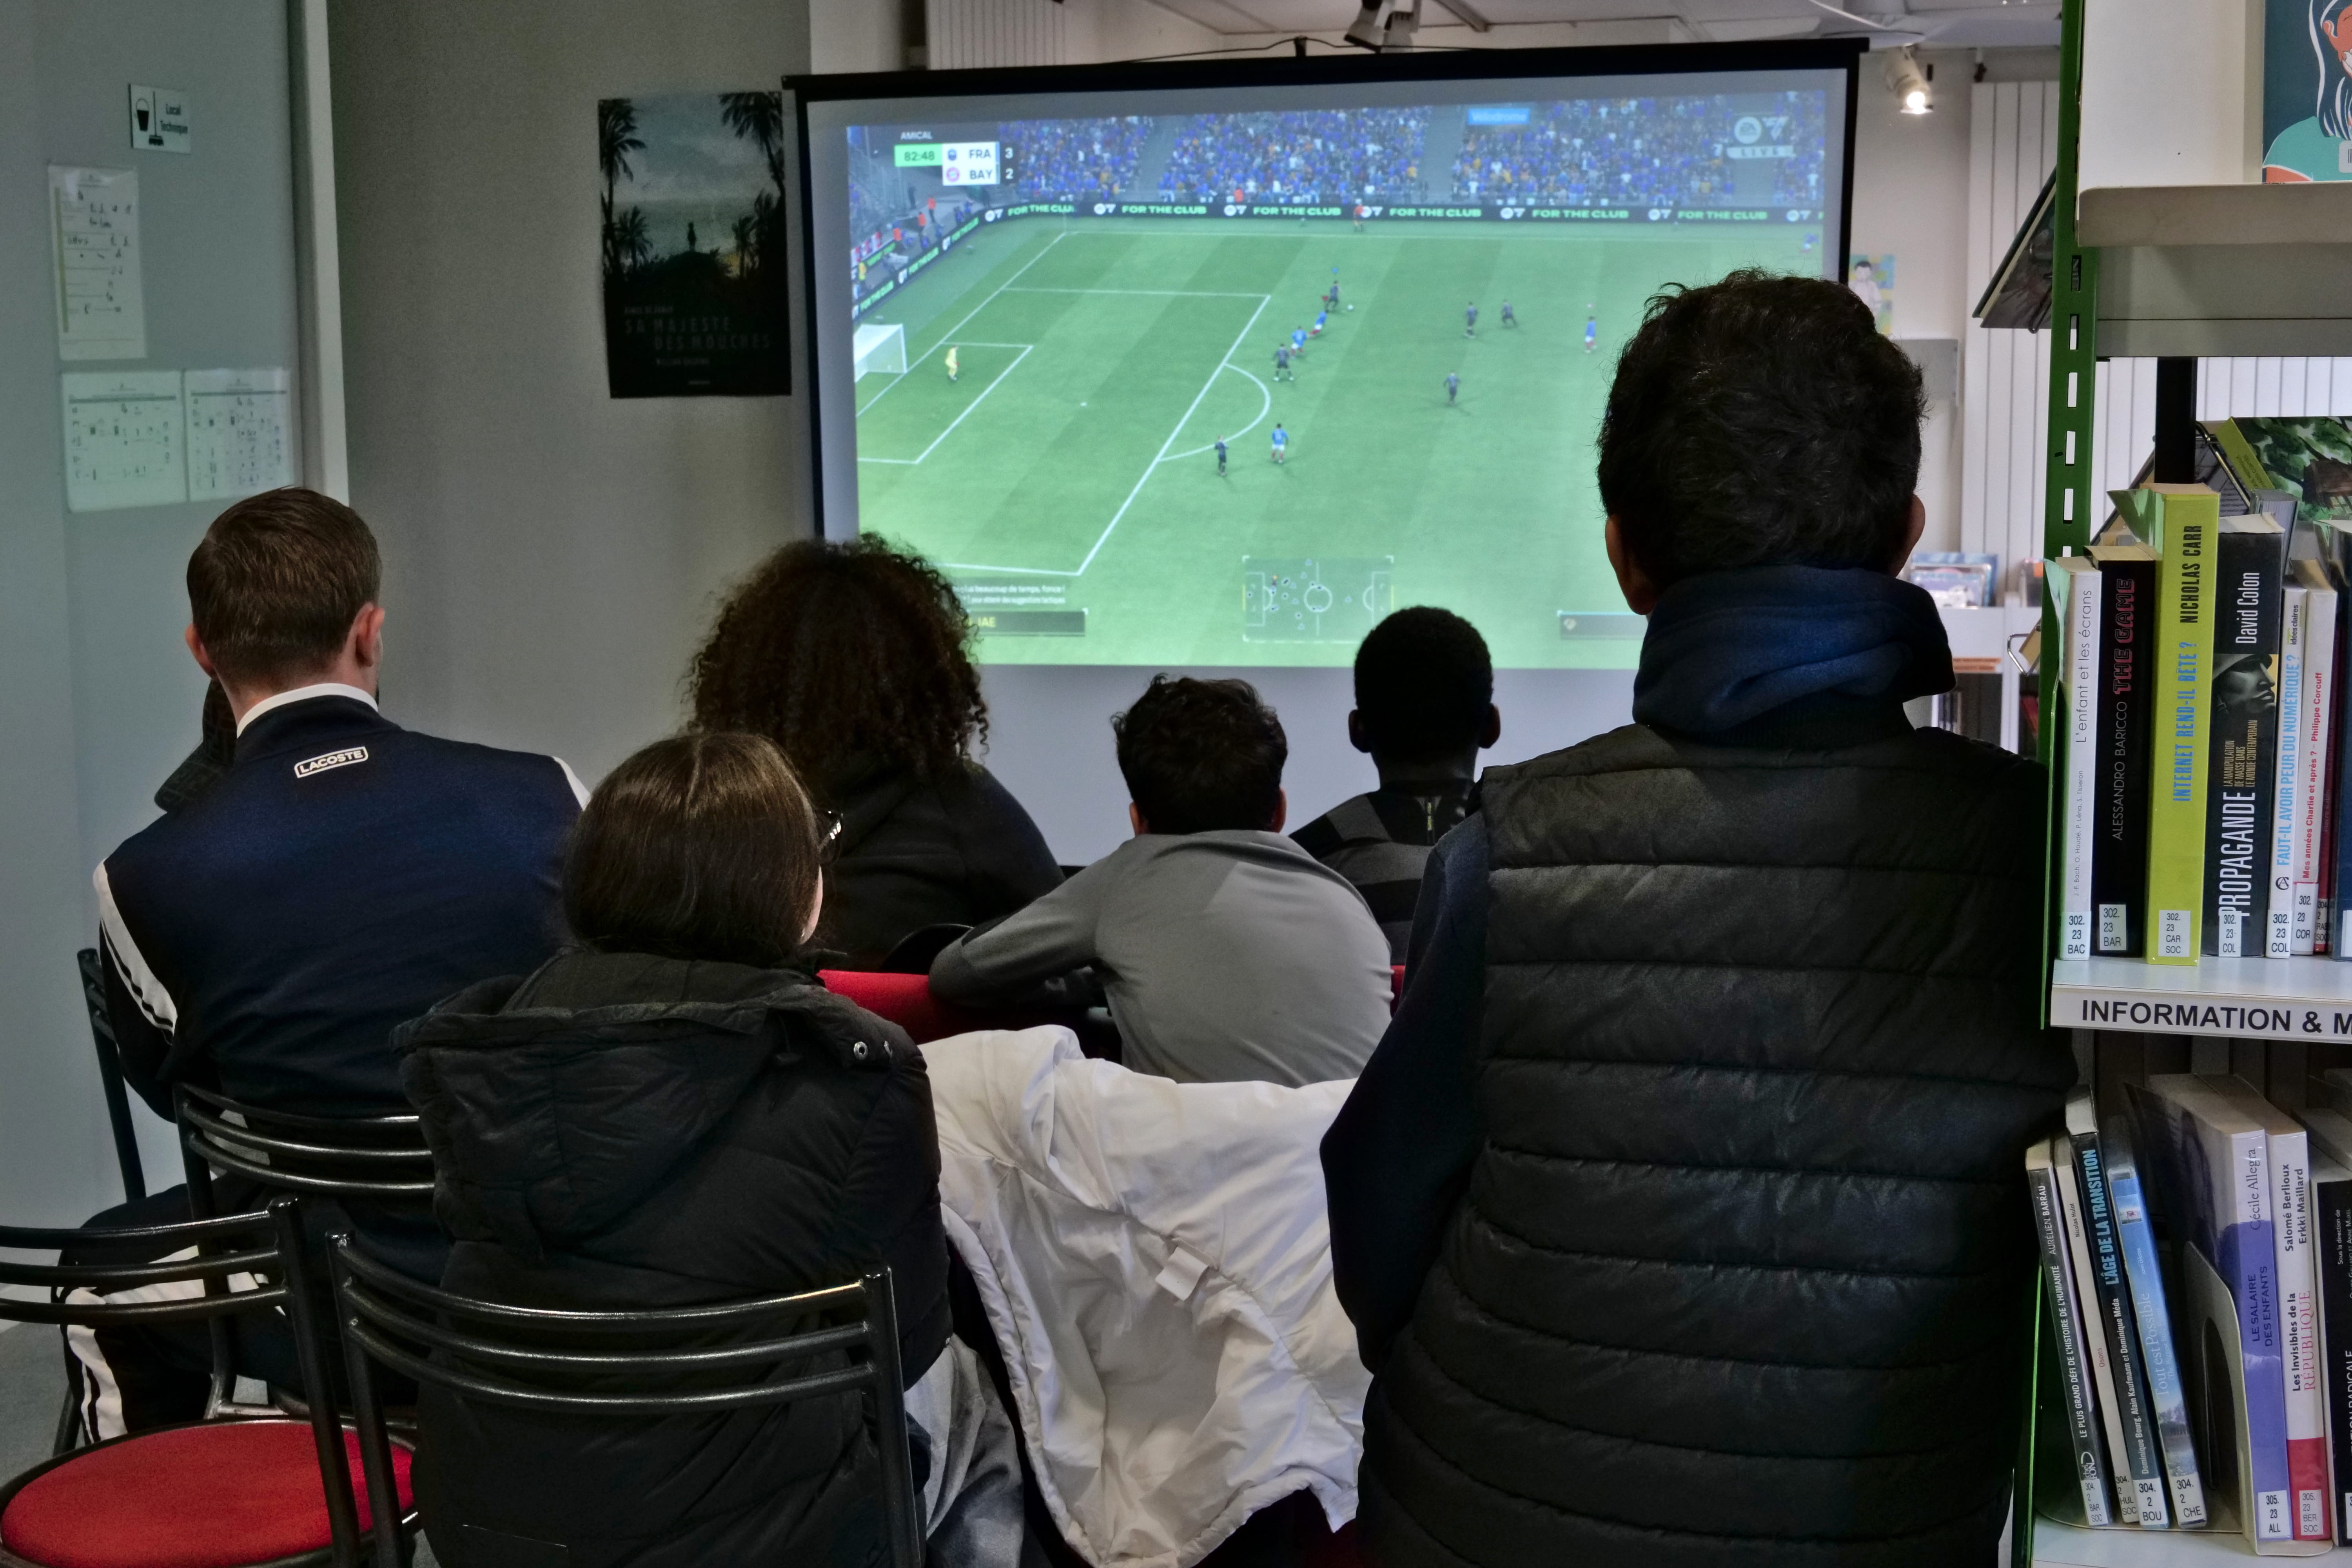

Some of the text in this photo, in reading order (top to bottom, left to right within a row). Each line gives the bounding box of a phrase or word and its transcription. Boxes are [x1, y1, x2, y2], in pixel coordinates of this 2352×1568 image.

[900, 131, 932, 140] AMICAL
[904, 151, 935, 161] 82:48
[969, 147, 1013, 159] FRA 3
[970, 168, 1014, 179] BAY 2
[1122, 205, 1207, 214] FOR THE CLUB
[1253, 206, 1341, 216] FOR THE CLUB
[1389, 208, 1482, 217] FOR THE CLUB
[1532, 209, 1629, 218] FOR THE CLUB
[1678, 211, 1768, 220] FOR THE CLUB
[625, 319, 645, 334] SA
[654, 333, 770, 350] DES MOUCHES
[2180, 525, 2202, 623] NICHOLAS CARR
[2236, 572, 2260, 644] David Colon
[2113, 579, 2135, 695] THE GAME
[2076, 590, 2092, 742] L'enfant et les écrans
[2314, 672, 2322, 704] Corcuff
[2282, 664, 2299, 732] NUMÉRIQUE
[2176, 688, 2196, 737] REND-IL
[2311, 707, 2321, 742] Philippe
[2247, 720, 2258, 761] CONTEMPORAIN
[2282, 735, 2296, 751] DU
[299, 750, 363, 773] LACOSTE
[2224, 740, 2234, 779] MANIPULATION
[2236, 746, 2245, 760] DANS
[2112, 702, 2127, 840] ALESSANDRO BARICCO
[2173, 744, 2194, 801] INTERNET
[2235, 760, 2245, 779] MASSE
[2246, 761, 2256, 780] MONDE
[2281, 753, 2295, 784] PEUR
[2308, 759, 2317, 782] après
[2279, 786, 2293, 821] AVOIR
[2306, 795, 2315, 826] Charlie
[2277, 826, 2292, 866] FAUT-IL
[2304, 828, 2312, 859] années
[2218, 792, 2255, 916] PROPAGANDE
[2303, 861, 2311, 878] Mes
[2299, 896, 2312, 905] 302.
[2069, 915, 2085, 925] 302.
[2103, 908, 2120, 918] 302.
[2224, 914, 2236, 924] 302.
[2273, 914, 2289, 924] 302.
[2298, 912, 2305, 922] 23
[2072, 930, 2082, 939] 23
[2103, 922, 2113, 932] 23
[2276, 929, 2286, 938] 23
[2296, 929, 2310, 939] COR
[2068, 944, 2085, 954] BAC
[2103, 937, 2121, 946] BAR
[2223, 943, 2236, 953] COL
[2271, 943, 2289, 953] COL
[2082, 1000, 2291, 1032] INFORMATION
[2302, 1011, 2322, 1033] &
[2246, 1148, 2260, 1230] Cécile Allegra
[2281, 1164, 2293, 1252] Salomé Berlioux
[2294, 1169, 2307, 1244] Erkki Maillard
[2038, 1185, 2056, 1254] AURÉLIEN BARRAU
[2082, 1149, 2119, 1285] L'ÂGE DE LA TRANSITION
[2112, 1298, 2122, 1317] Méda
[2248, 1274, 2260, 1342] LE SALAIRE
[2260, 1266, 2272, 1346] DES ENFANTS
[2117, 1318, 2128, 1353] Dominique
[2287, 1293, 2301, 1391] Les Invisibles de la
[2299, 1290, 2316, 1390] RÉPUBLIQUE
[2050, 1265, 2087, 1438] LE PLUS GRAND DÉFI DE L'HISTOIRE DE L'HUMANITÉ
[2137, 1293, 2169, 1398] Tout est Possible
[2123, 1363, 2135, 1397] Kaufmann
[2129, 1397, 2139, 1414] Alain
[2133, 1416, 2143, 1438] Bourg,
[2135, 1439, 2149, 1474] Dominique
[2116, 1475, 2129, 1484] 304.
[2139, 1483, 2156, 1493] 304.
[2176, 1479, 2194, 1489] 304.
[2120, 1496, 2134, 1504] HUL
[2147, 1497, 2152, 1506] 2
[2180, 1494, 2186, 1504] 2
[2266, 1495, 2279, 1504] 305.
[2122, 1507, 2136, 1515] SOC
[2142, 1511, 2162, 1521] BOU
[2183, 1506, 2202, 1517] CHE
[2270, 1509, 2278, 1519] 23
[2269, 1523, 2281, 1533] ALL
